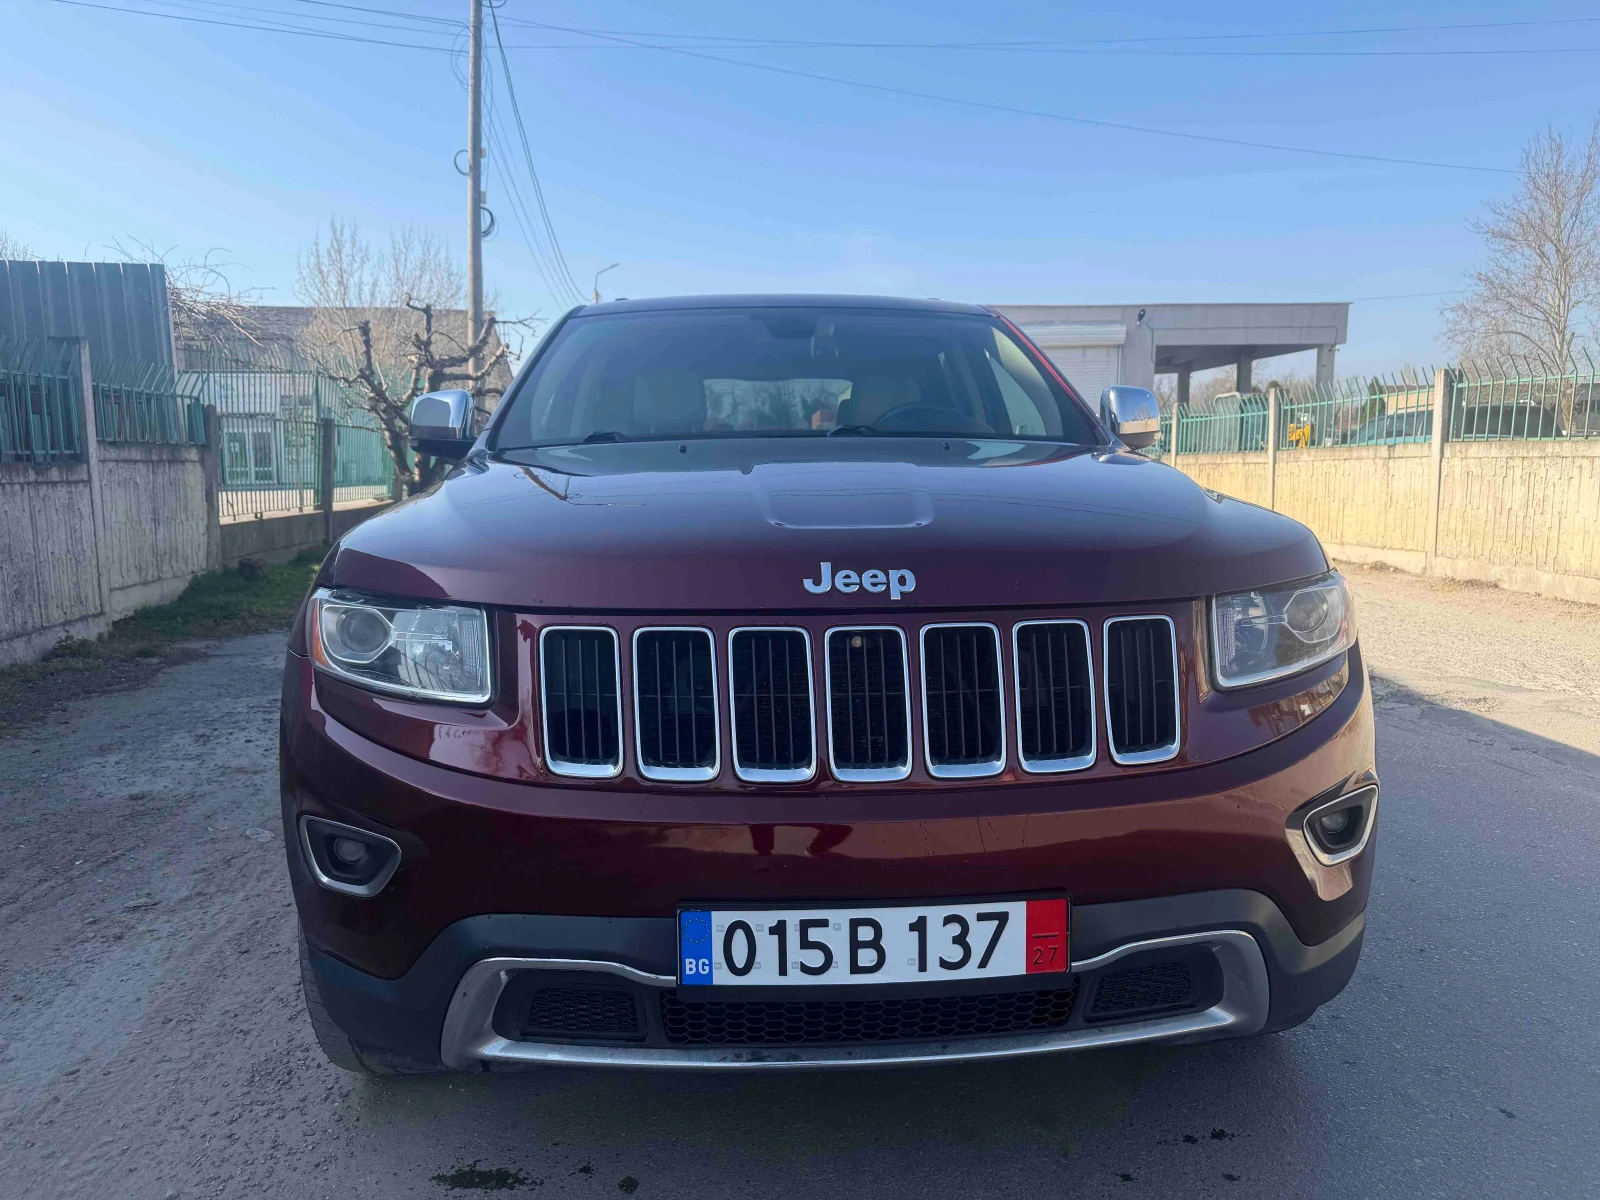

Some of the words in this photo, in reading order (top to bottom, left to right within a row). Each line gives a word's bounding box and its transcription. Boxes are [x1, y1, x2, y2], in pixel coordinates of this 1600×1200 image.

[803, 562, 916, 600] Jeep
[723, 917, 886, 976] 015B
[909, 911, 1009, 972] 137
[1033, 945, 1058, 965] 27
[685, 958, 709, 975] BG
